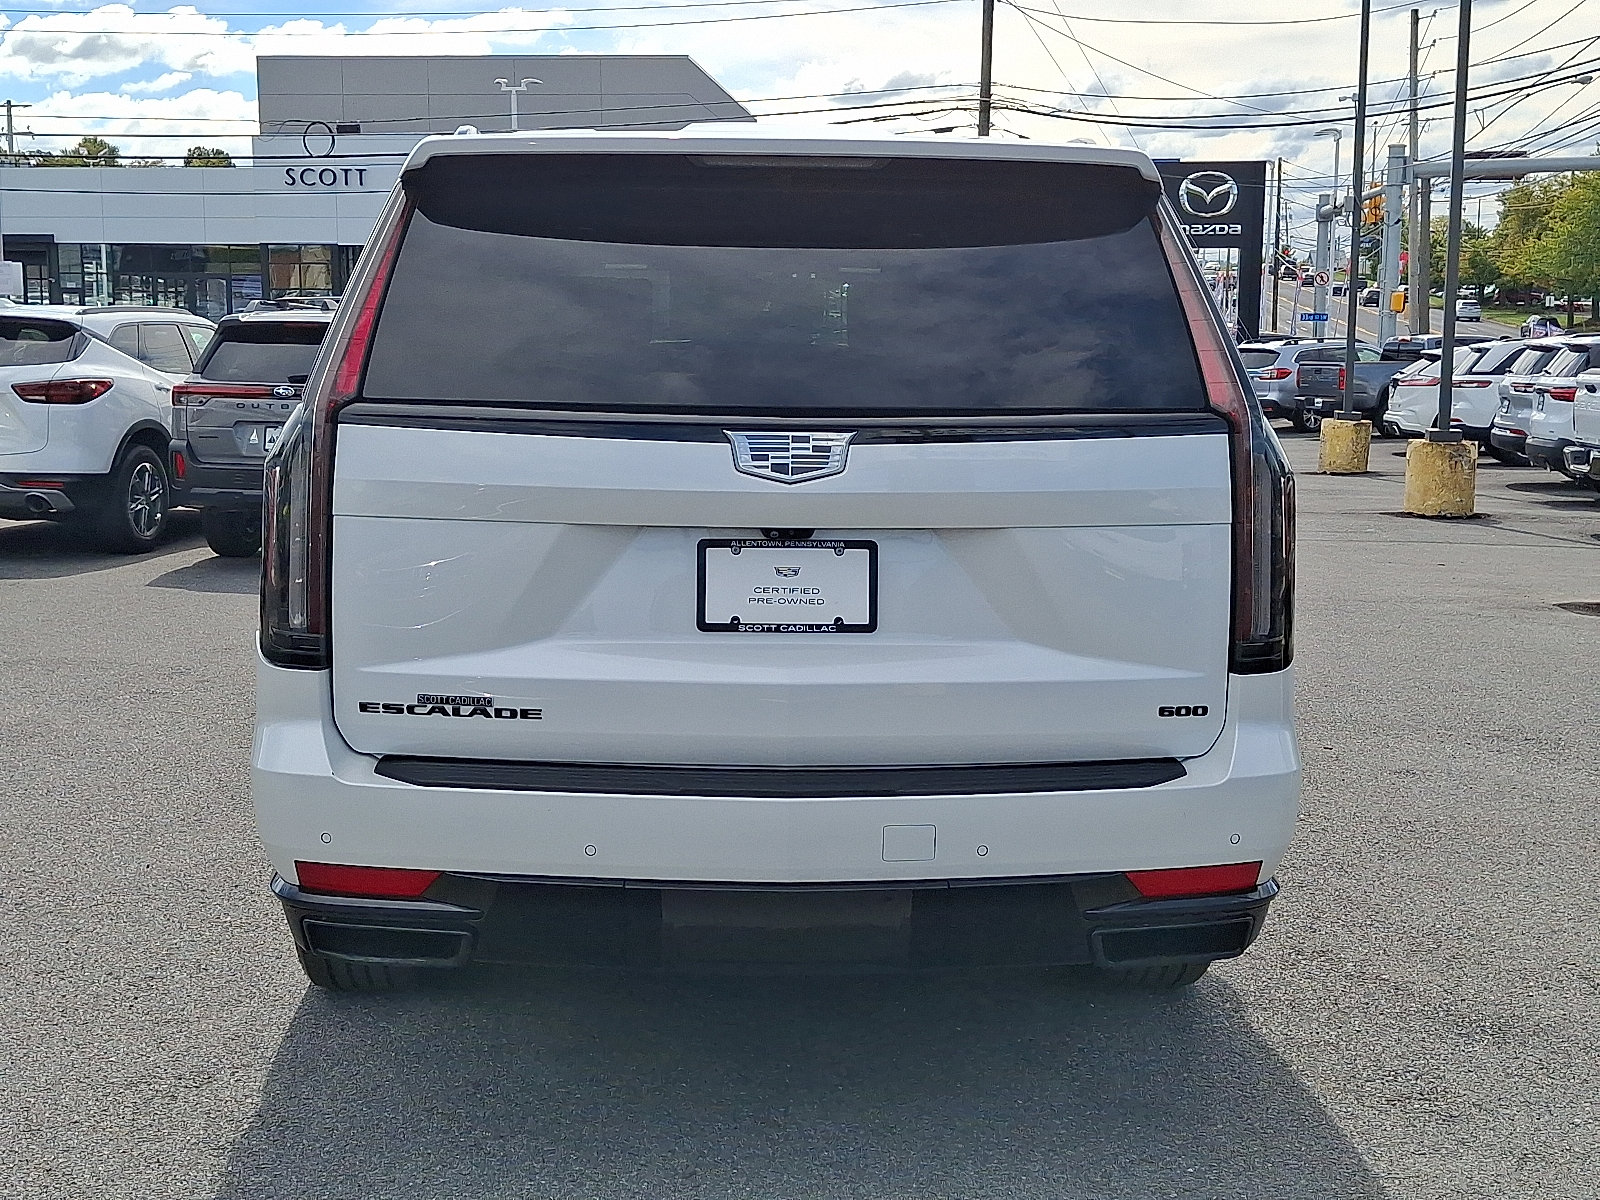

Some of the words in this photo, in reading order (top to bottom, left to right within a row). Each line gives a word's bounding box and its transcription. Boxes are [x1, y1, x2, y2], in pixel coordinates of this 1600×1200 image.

[284, 168, 367, 186] SCOTT
[730, 540, 784, 548] ALLENTOWN,
[784, 540, 846, 548] PENNSYLVANIA
[753, 586, 821, 595] CERTIFIED
[748, 597, 825, 606] PRE-OWNED
[738, 624, 777, 632] SCOTT
[779, 624, 837, 632] CADILLAC
[418, 694, 447, 705] SCOTT
[448, 695, 493, 707] CADILLAC
[358, 701, 543, 720] ESCALADE
[1158, 705, 1209, 717] 600
